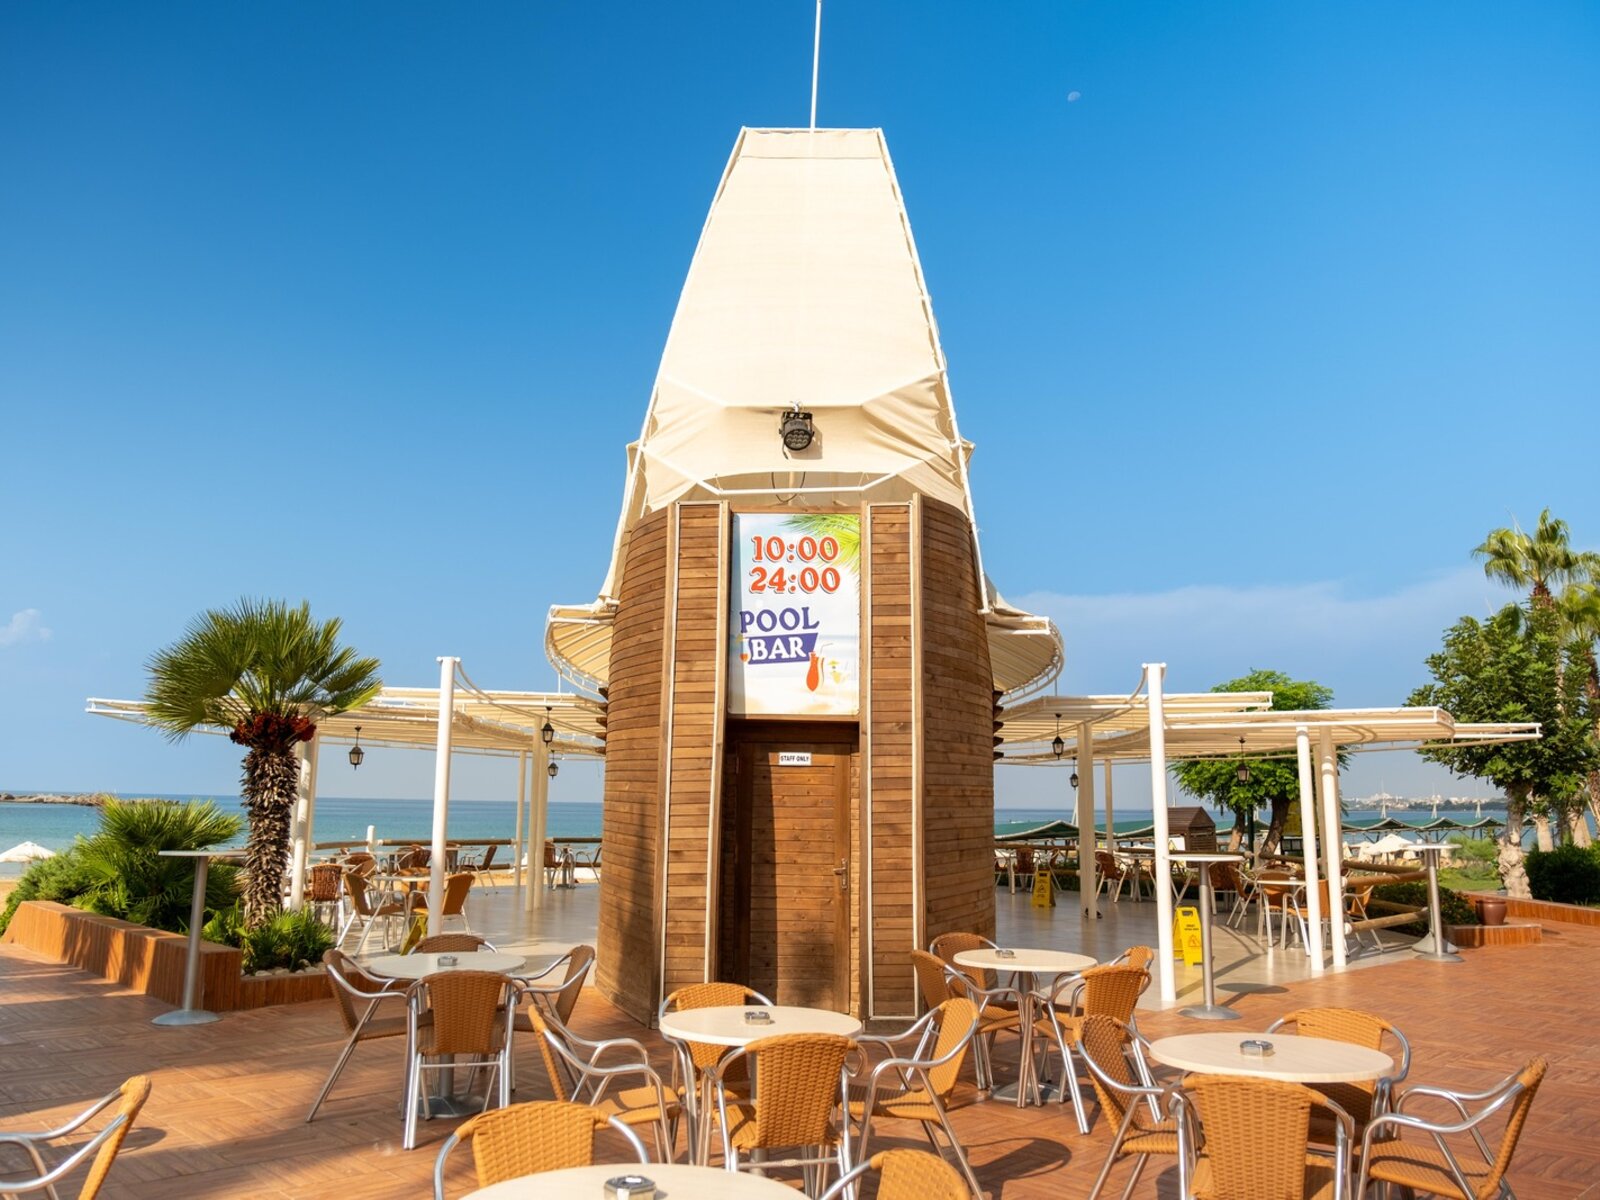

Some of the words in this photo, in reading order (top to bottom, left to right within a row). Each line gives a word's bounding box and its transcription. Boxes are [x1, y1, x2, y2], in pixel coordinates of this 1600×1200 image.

[751, 535, 839, 562] 10:00
[749, 566, 841, 594] 24:00
[739, 606, 820, 633] POOL
[750, 637, 807, 661] BAR
